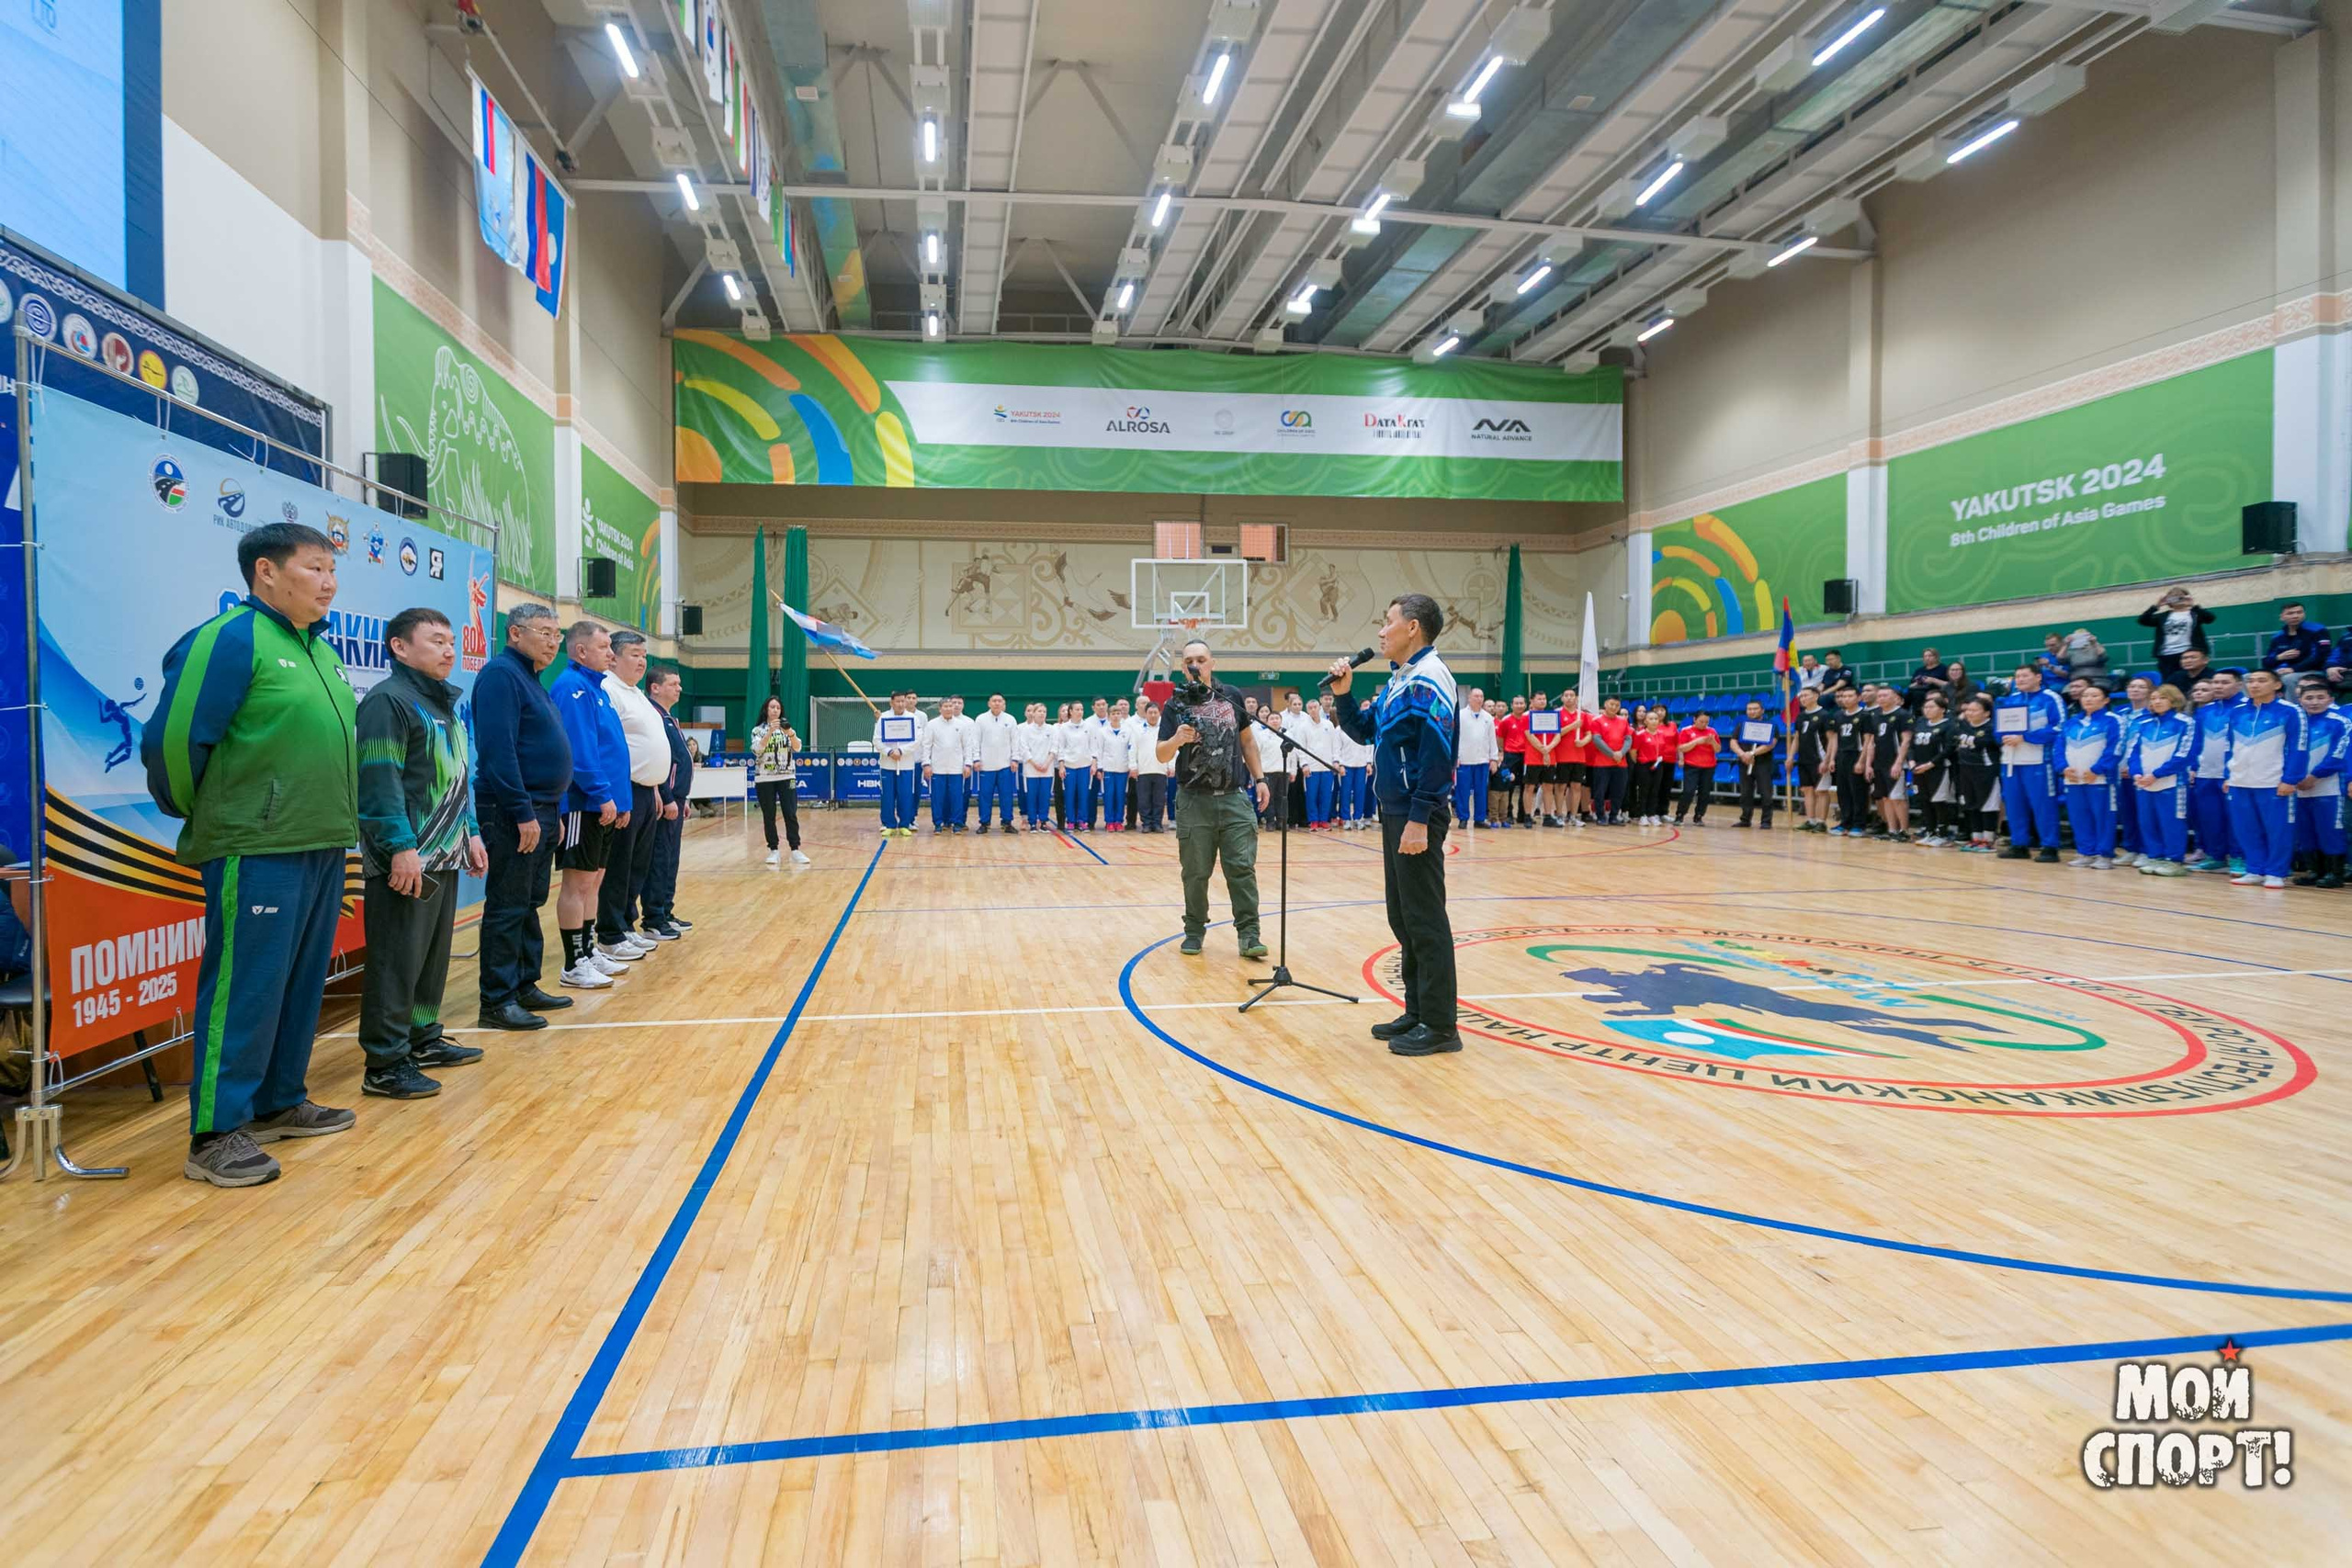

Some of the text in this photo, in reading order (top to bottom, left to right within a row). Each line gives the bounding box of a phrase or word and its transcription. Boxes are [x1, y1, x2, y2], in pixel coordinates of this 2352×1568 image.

[1011, 410, 1042, 418] YAKUTSK
[1106, 420, 1170, 434] ALROSA
[1951, 453, 2167, 522] YAKUTSK 2024
[596, 516, 620, 544] YAKUTSK
[1950, 495, 2167, 547] 8th Children of Asia Games
[463, 626, 477, 652] 80
[1840, 723, 1853, 736] 12
[1878, 723, 1887, 737] 9
[73, 988, 121, 1028] 1945
[138, 971, 177, 1007] 2025
[1552, 1042, 1745, 1080] ЦЕНТР
[1770, 1056, 2275, 1106] РЕСПУБЛИКАНСКИЙ
